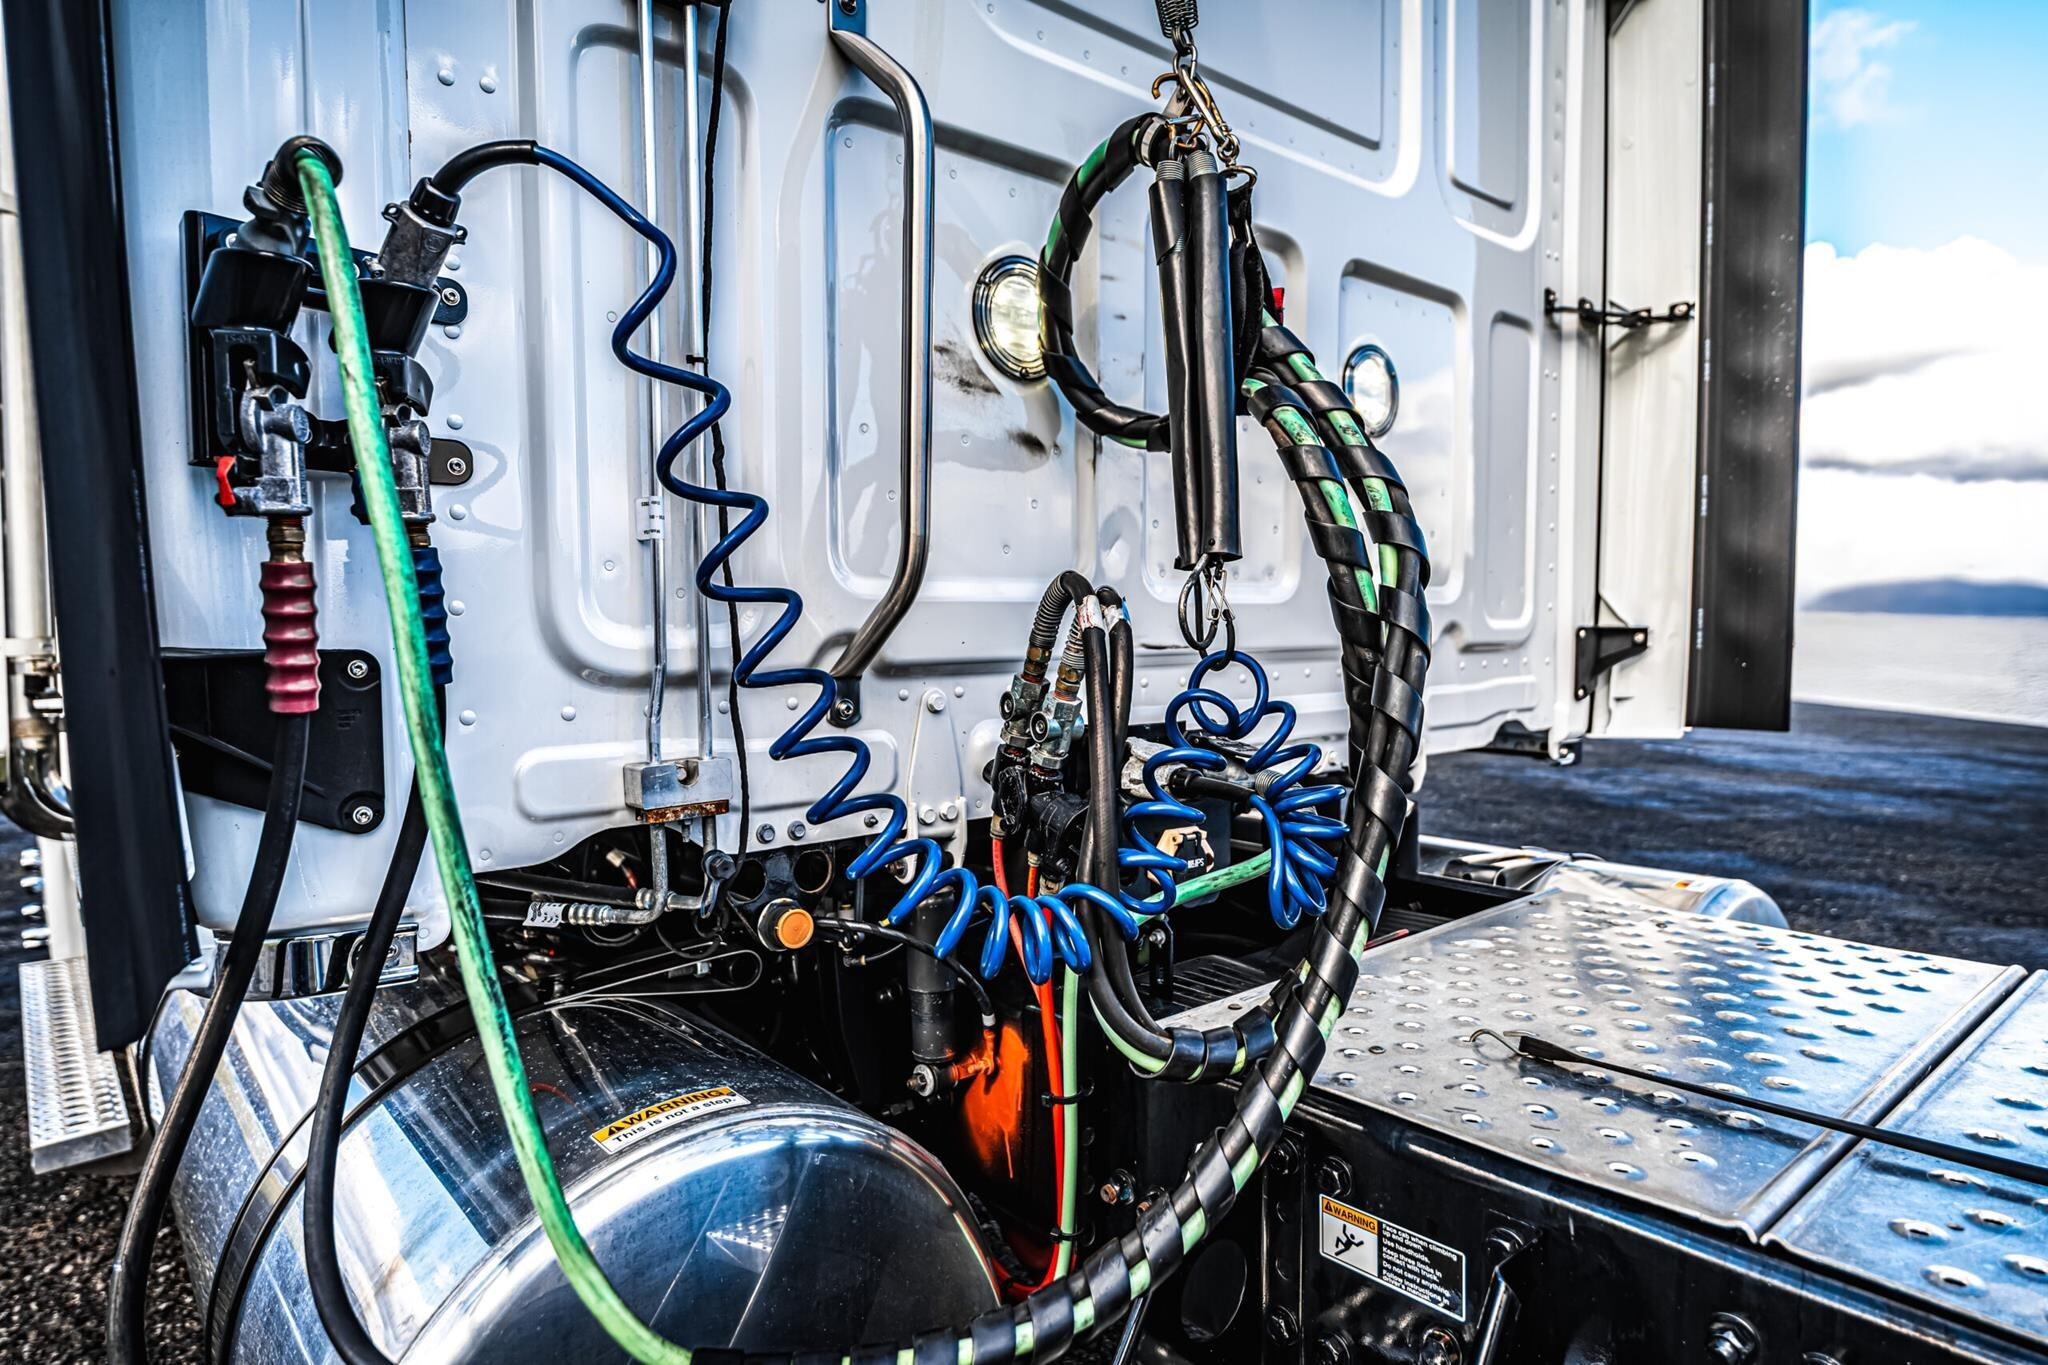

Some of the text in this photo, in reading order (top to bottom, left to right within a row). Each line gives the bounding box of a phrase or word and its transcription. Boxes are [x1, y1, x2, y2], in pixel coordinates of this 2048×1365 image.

[612, 1126, 646, 1143] This
[650, 1119, 662, 1127] is
[665, 1109, 687, 1119] not
[704, 1097, 736, 1108] step.
[623, 1090, 725, 1126] WARNING
[665, 1109, 687, 1119] not
[1333, 1206, 1376, 1230] WARNING
[1382, 1237, 1394, 1247] Use
[1382, 1223, 1457, 1262] Face cab when climbing
[1382, 1246, 1398, 1258] Keep
[1398, 1253, 1415, 1265] three
[1416, 1261, 1434, 1274] limbs
[1382, 1252, 1405, 1267] contact
[1406, 1262, 1420, 1273] with
[1382, 1260, 1391, 1269] Do
[1382, 1269, 1402, 1283] Follow
[1403, 1278, 1442, 1302] instructions
[1403, 1270, 1420, 1284] carry
